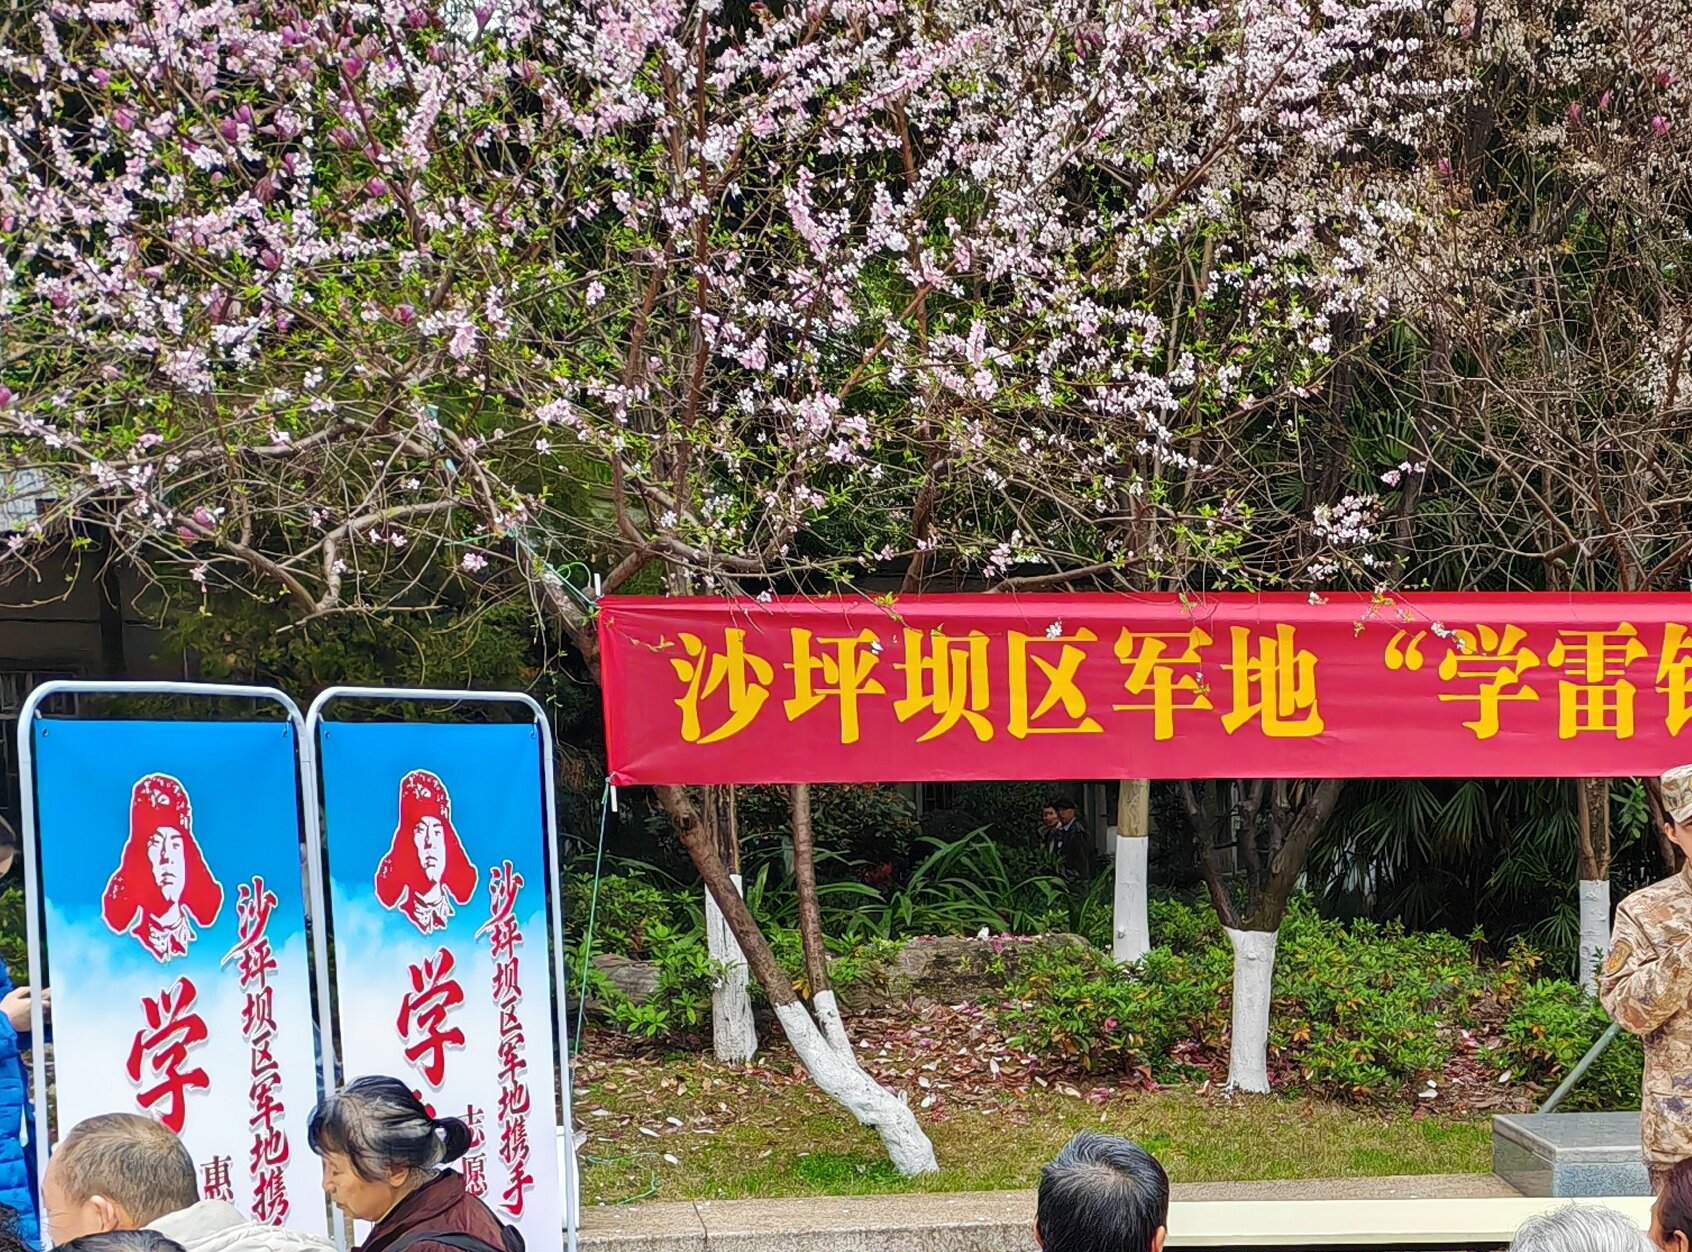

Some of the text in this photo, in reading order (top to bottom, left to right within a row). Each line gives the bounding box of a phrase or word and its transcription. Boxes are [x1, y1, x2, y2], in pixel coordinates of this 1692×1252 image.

[672, 626, 1325, 744] 沙坪坝区军地
[231, 877, 291, 1226] 沙坪坝区军地携
[396, 948, 465, 1119] 学
[475, 860, 535, 1216] 沙坪坝区军地携手
